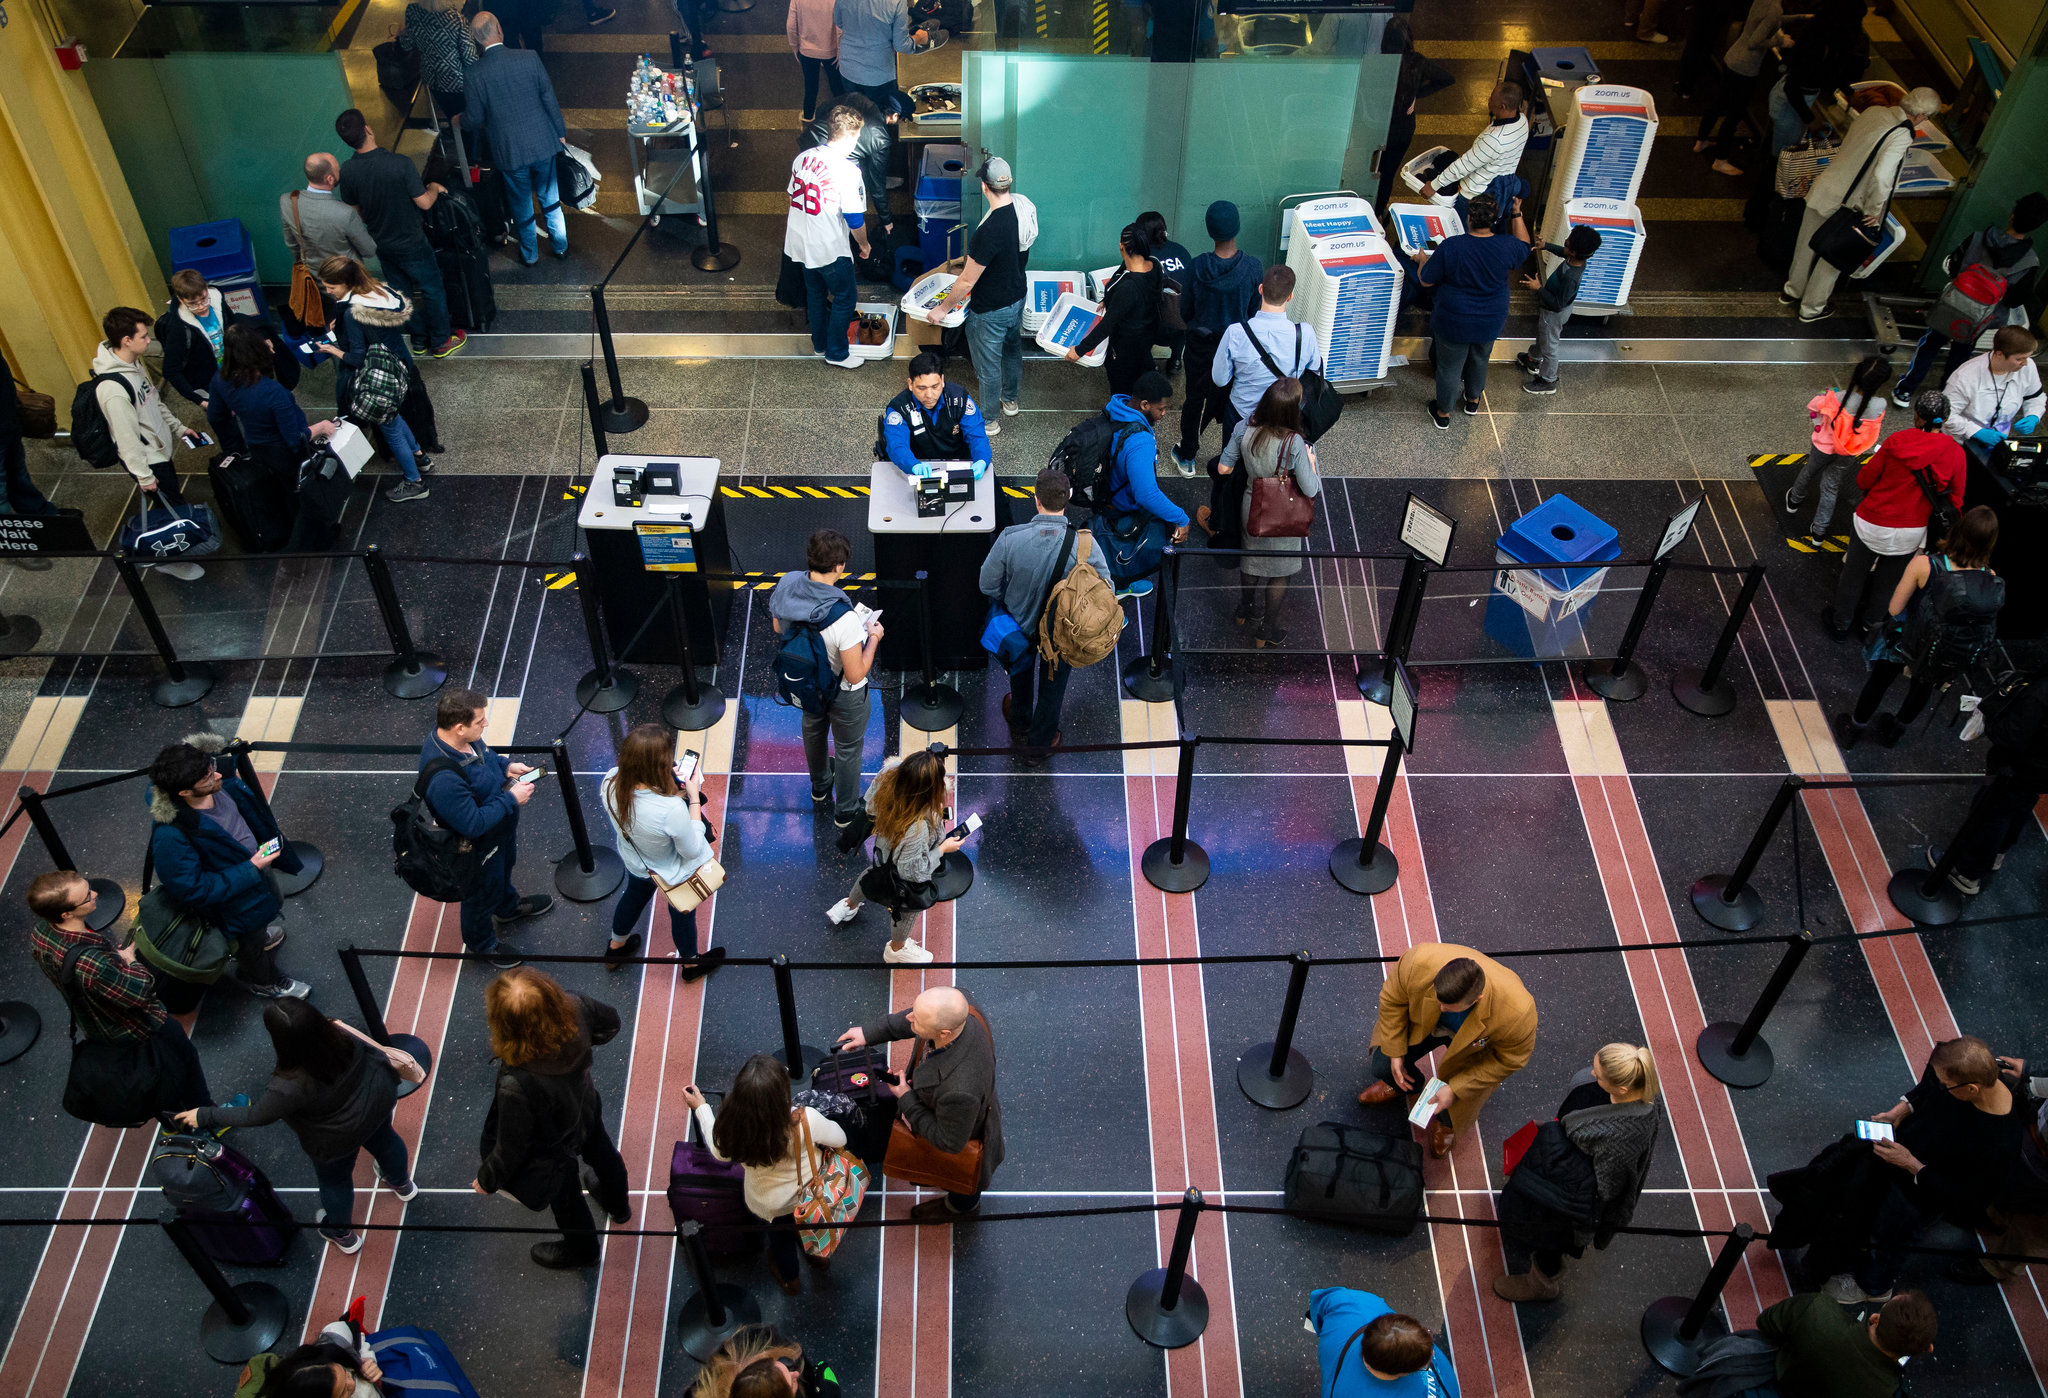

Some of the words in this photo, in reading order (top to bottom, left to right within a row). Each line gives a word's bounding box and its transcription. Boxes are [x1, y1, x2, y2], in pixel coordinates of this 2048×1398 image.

[1595, 90, 1631, 98] zoom.us
[791, 177, 821, 216] 28
[1314, 202, 1349, 211] zoom.us
[1583, 202, 1619, 210] zoom.us
[1330, 241, 1366, 250] zoom.us
[1057, 335, 1066, 345] eet
[1062, 318, 1079, 337] Happy.
[0, 518, 44, 528] lease
[0, 540, 39, 550] Here
[1521, 590, 1535, 603] Only
